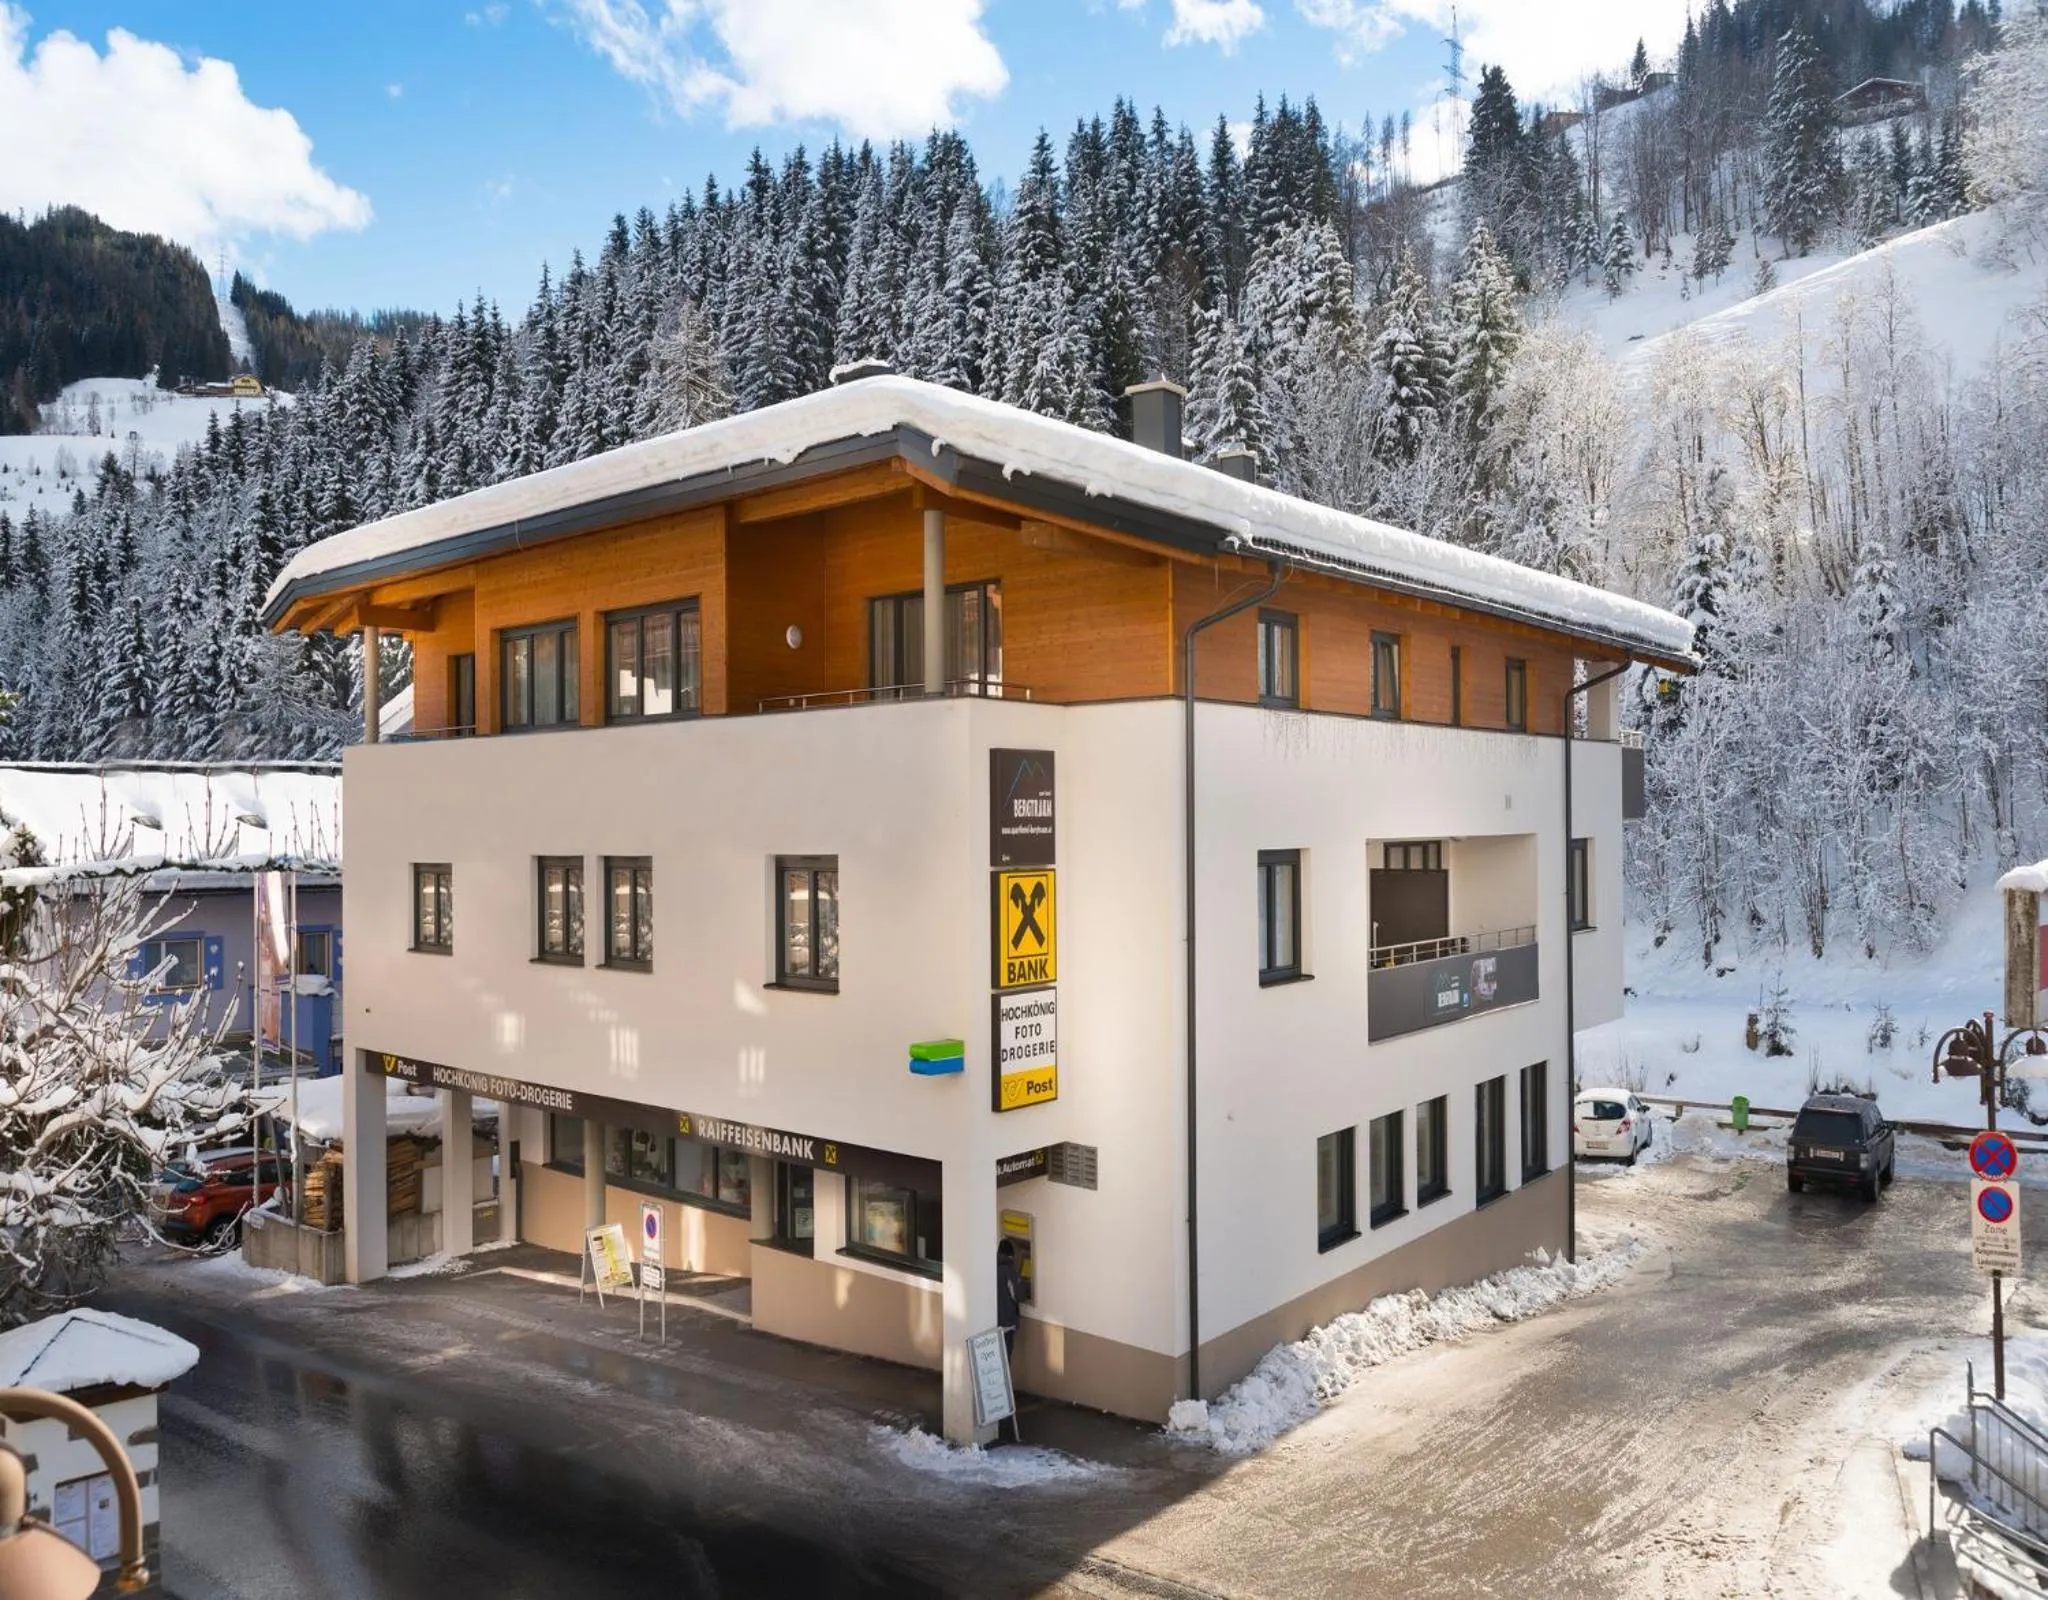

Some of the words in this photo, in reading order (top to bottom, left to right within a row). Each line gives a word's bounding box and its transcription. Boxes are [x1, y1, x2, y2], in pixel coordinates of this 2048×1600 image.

[1007, 958, 1048, 984] BANK
[1001, 1001, 1055, 1022] HOCHKÖNIG
[1015, 1023, 1042, 1040] FOTO
[1001, 1040, 1055, 1062] DROGERIE
[398, 1060, 417, 1077] Post
[490, 1078, 573, 1111] FOTO-DROGERIE
[1026, 1078, 1053, 1096] Post
[698, 1119, 814, 1160] RAIFFEISENBANK
